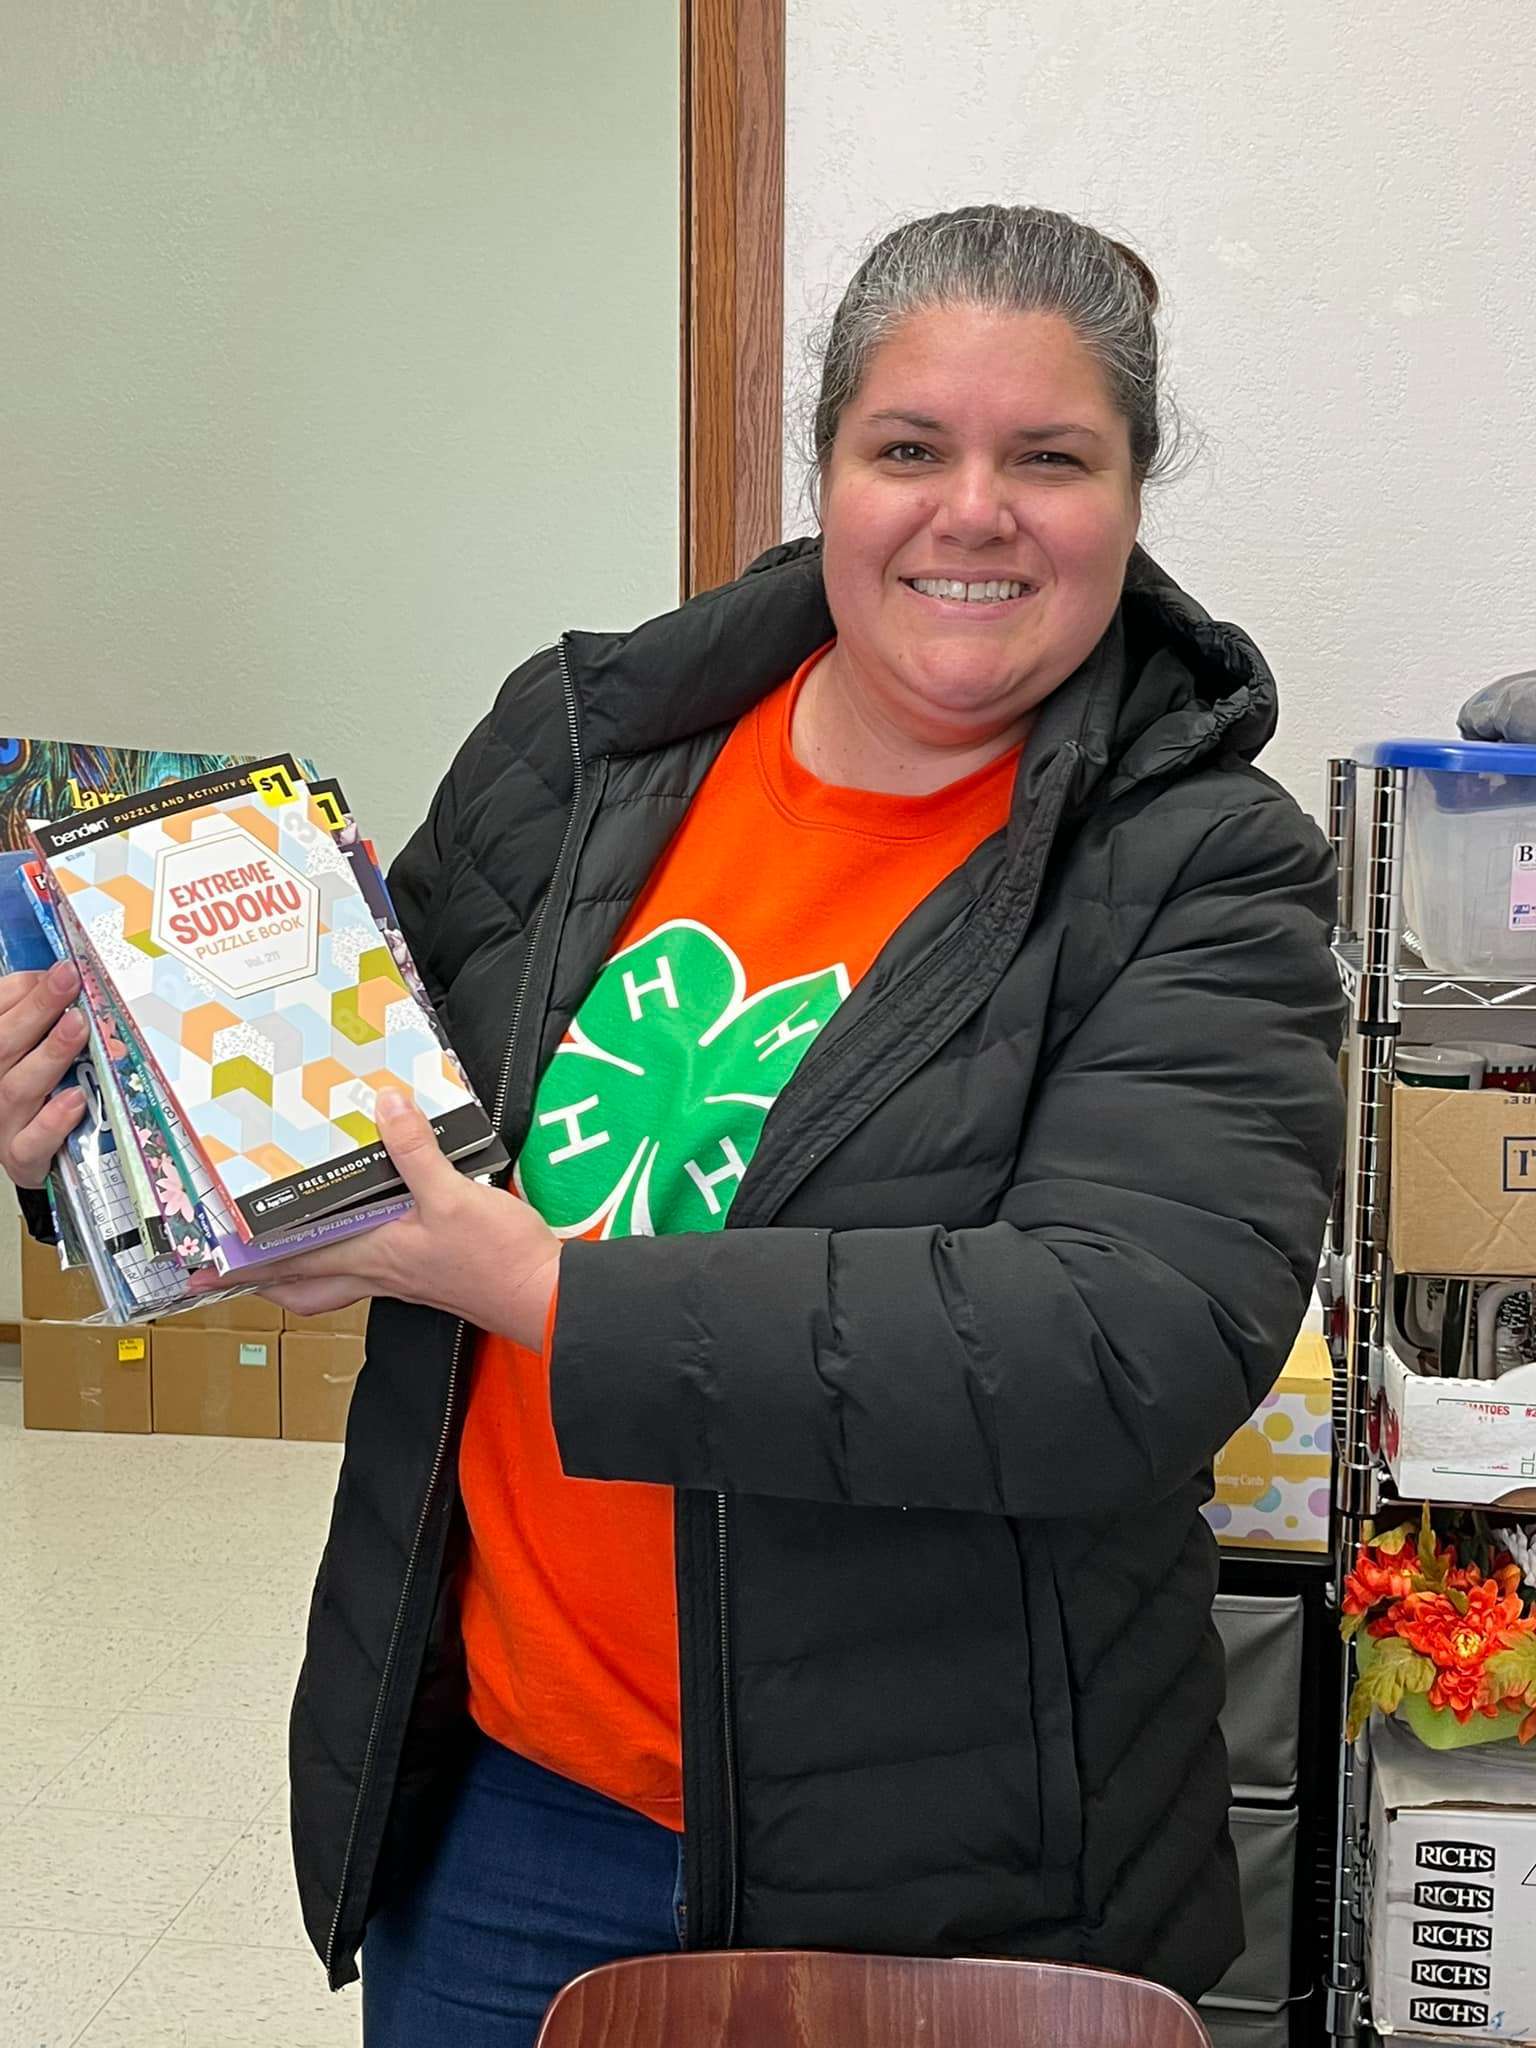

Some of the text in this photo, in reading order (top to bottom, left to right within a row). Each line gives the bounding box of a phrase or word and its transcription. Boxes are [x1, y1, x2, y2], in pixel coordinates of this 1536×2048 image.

[258, 772, 293, 798] $1
[50, 818, 110, 847] bendon
[113, 803, 160, 824] PUZZLE
[161, 795, 184, 809] AND
[187, 780, 236, 800] ACTIVITY
[1518, 845, 1536, 862] B
[168, 860, 275, 909] EXTREME
[169, 880, 301, 945] SUDOKU
[195, 915, 305, 960] PUZZLE BOOK
[622, 956, 679, 1022] H
[754, 1000, 819, 1061] H
[132, 1063, 159, 1107] SUDOKU
[538, 1094, 611, 1165] H
[297, 1175, 325, 1192] FREE
[326, 1157, 371, 1180] BENDON
[372, 1150, 388, 1161] PU
[683, 1135, 747, 1215] H
[260, 1230, 317, 1250] Challenging
[317, 1217, 354, 1236] puzzles
[355, 1211, 366, 1221] to
[1418, 1845, 1493, 1869] RICH'S
[1418, 1885, 1491, 1909] RICH'S
[1416, 1925, 1490, 1949] RICH'S
[1415, 1963, 1488, 1987] RICH'S
[1413, 2001, 1486, 2024] RICH'S
